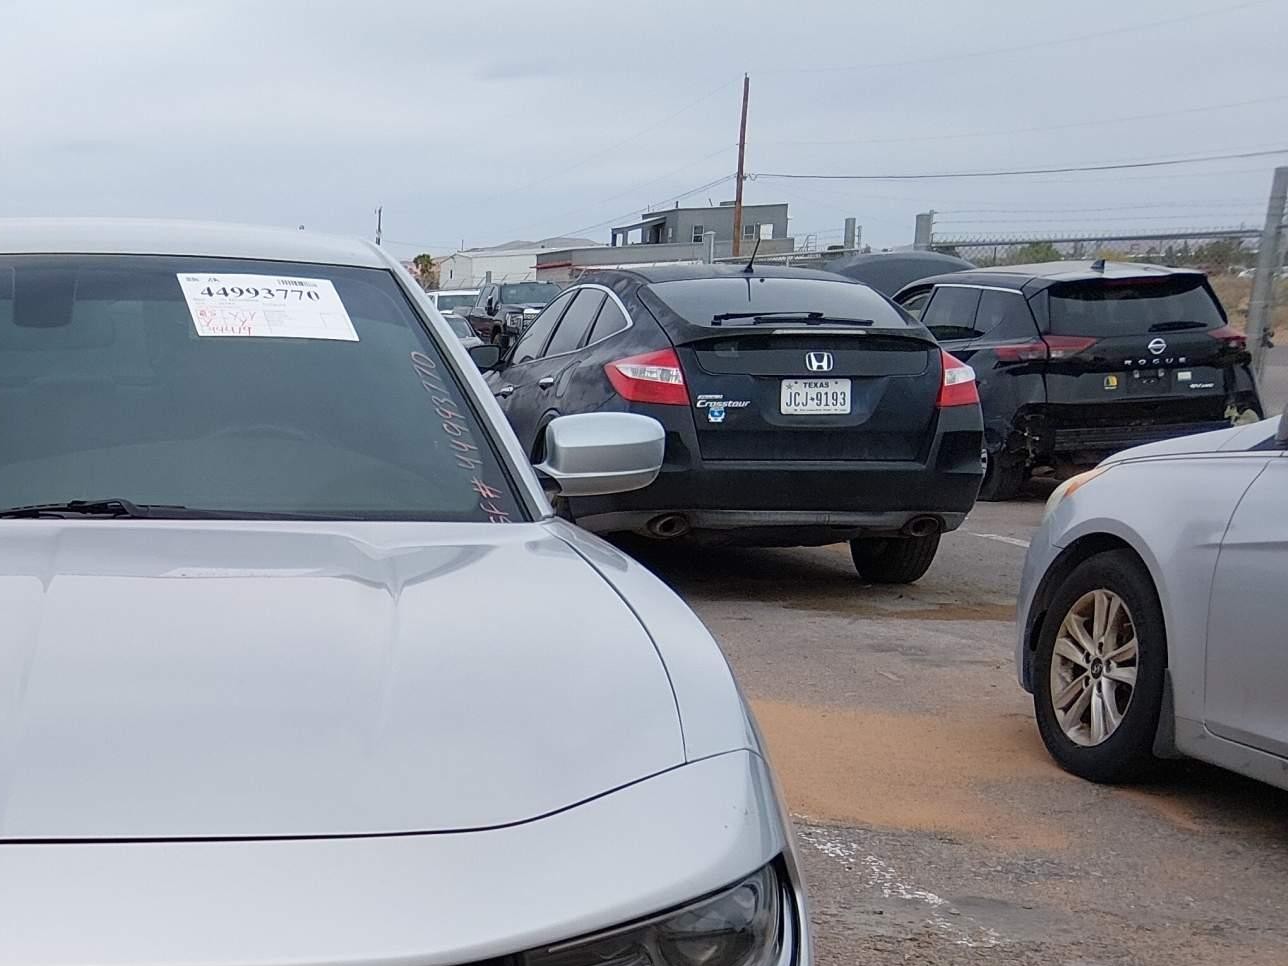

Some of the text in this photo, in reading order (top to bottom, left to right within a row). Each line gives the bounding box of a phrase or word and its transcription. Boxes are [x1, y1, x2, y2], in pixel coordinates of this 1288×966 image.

[200, 286, 320, 301] 44993770
[1124, 357, 1186, 366] ROGUE
[802, 381, 830, 389] TEXAS
[696, 399, 751, 408] Crosstour
